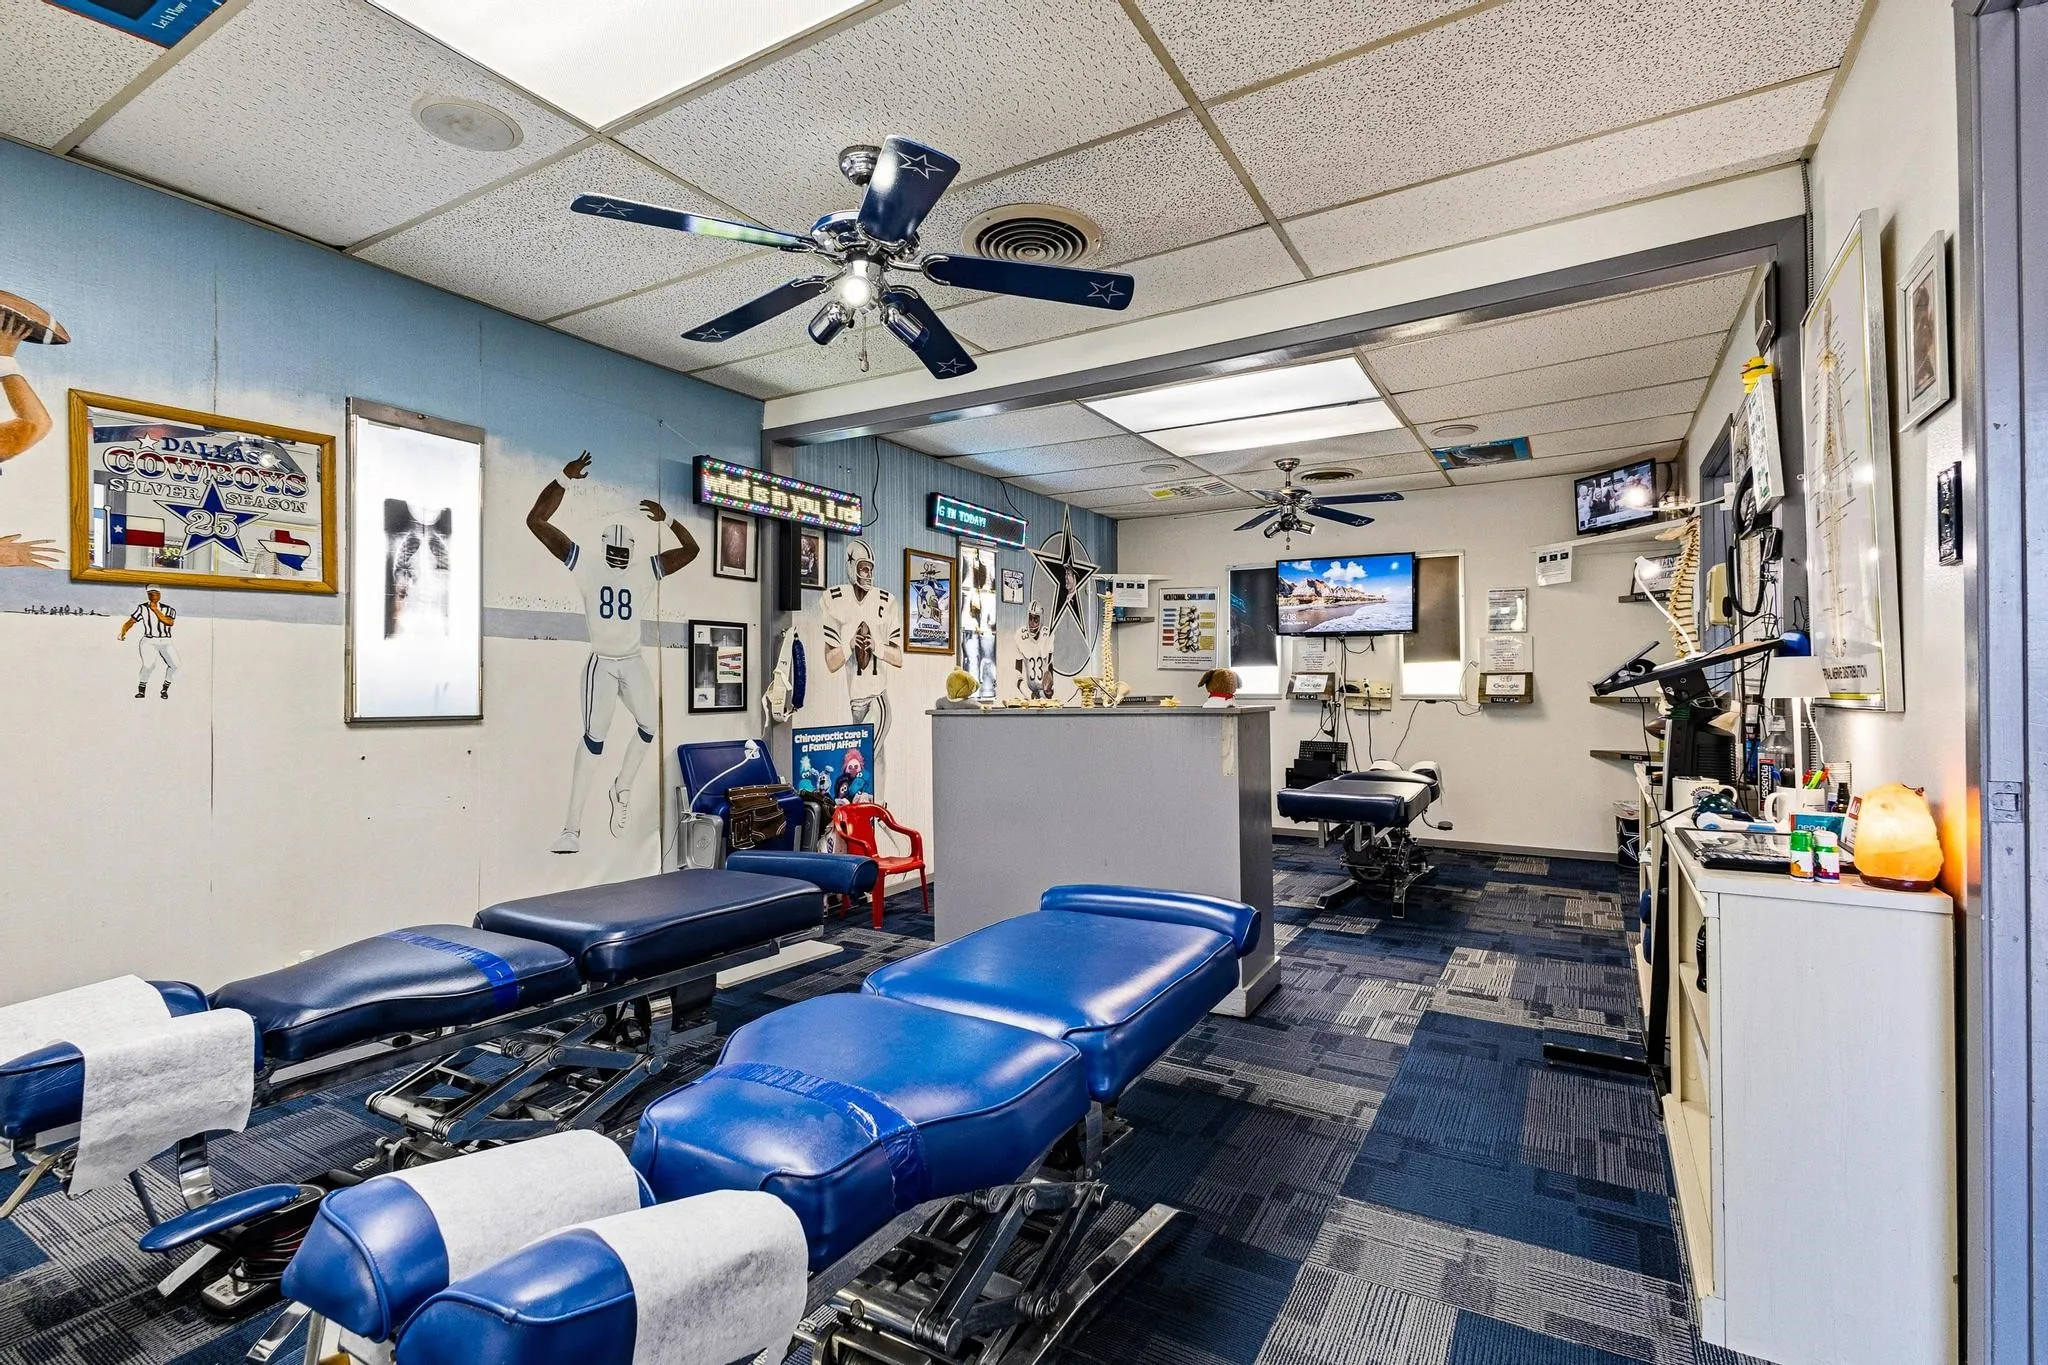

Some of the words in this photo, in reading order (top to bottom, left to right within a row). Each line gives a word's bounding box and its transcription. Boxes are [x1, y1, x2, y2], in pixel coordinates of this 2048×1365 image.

[161, 437, 261, 464] DALLAS
[103, 446, 309, 497] COWBOYS
[109, 478, 200, 500] SILVER
[225, 491, 308, 513] SEASON
[771, 486, 788, 507] in
[185, 509, 240, 538] 25
[958, 511, 986, 527] TODAY!
[600, 586, 632, 620] 88
[1029, 656, 1043, 681] 33
[794, 731, 843, 744] Chiropractic
[844, 730, 861, 739] Care
[802, 744, 808, 752] a
[809, 742, 836, 752] Family
[836, 739, 862, 749] Affair!
